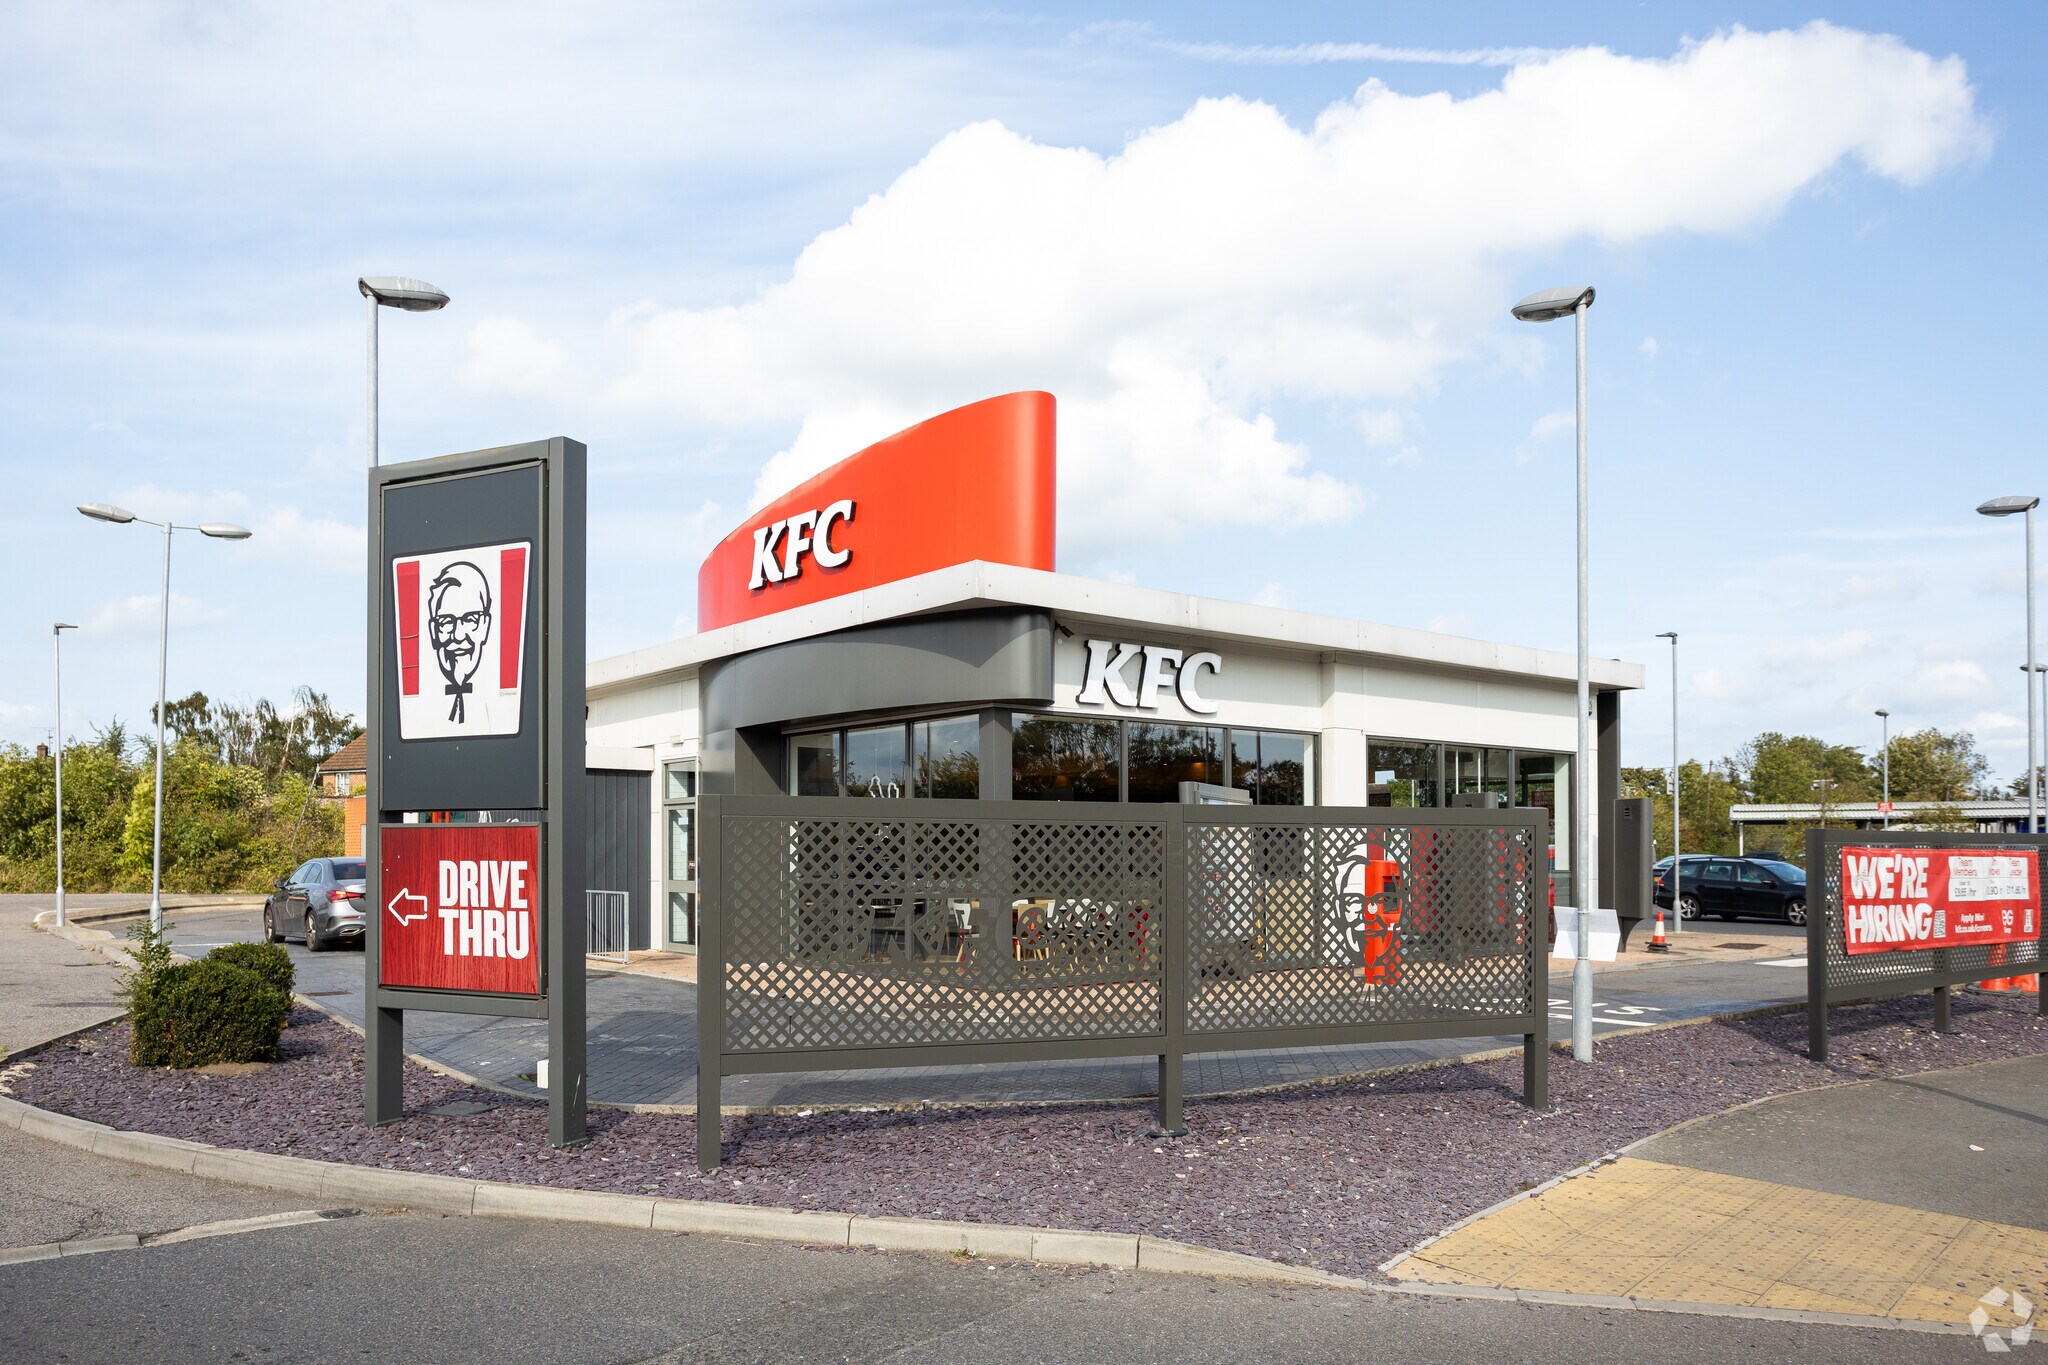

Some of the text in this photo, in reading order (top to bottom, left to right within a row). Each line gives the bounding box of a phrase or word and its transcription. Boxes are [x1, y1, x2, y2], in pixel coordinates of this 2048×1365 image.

[748, 499, 857, 590] KFC
[1076, 639, 1222, 714] KFC
[439, 860, 528, 909] DRIVE
[1847, 854, 1929, 899] WE'RE
[438, 908, 529, 960] THRU
[1848, 903, 1933, 943] HIRING
